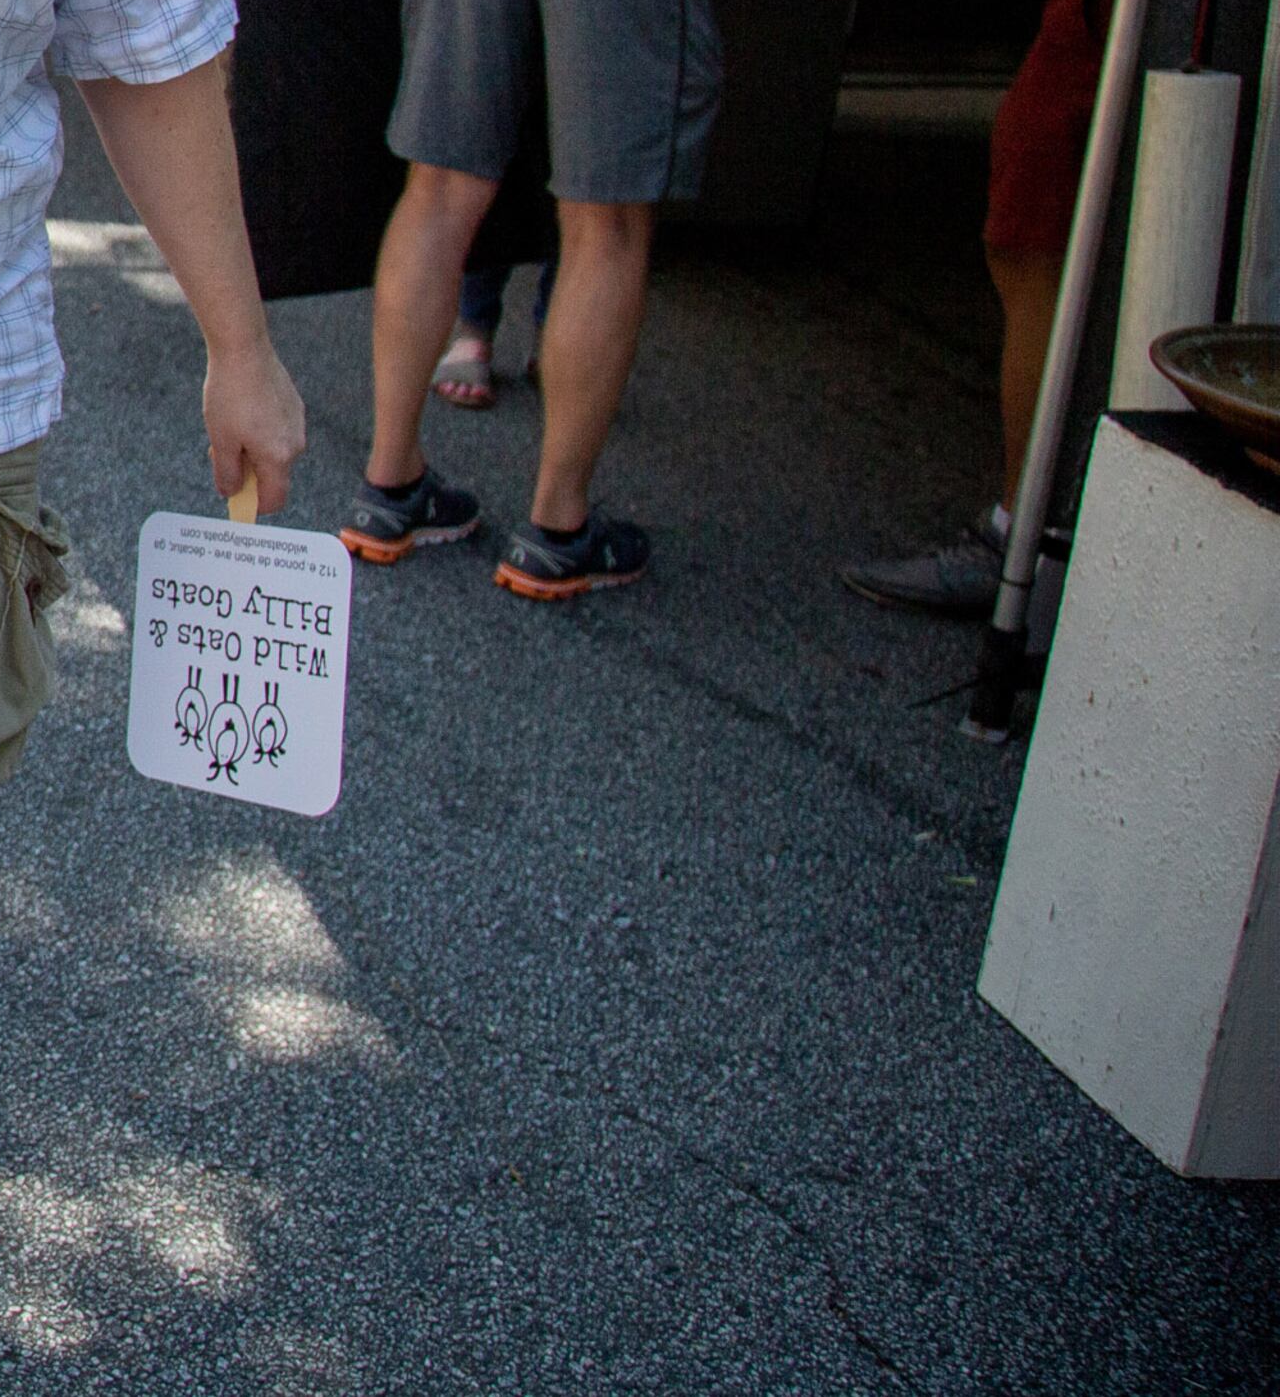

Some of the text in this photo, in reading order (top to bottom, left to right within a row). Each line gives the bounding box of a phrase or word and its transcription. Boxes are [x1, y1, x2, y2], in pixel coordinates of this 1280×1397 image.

[154, 539, 166, 552] ga
[180, 528, 308, 553] wildoatsandbillygoats.com
[214, 549, 231, 560] ave
[235, 553, 256, 566] leon
[258, 557, 271, 567] de
[273, 558, 306, 571] ponce
[319, 564, 338, 578] 112
[152, 578, 332, 635] Billy Goats
[149, 619, 329, 678] Wild Oats &
